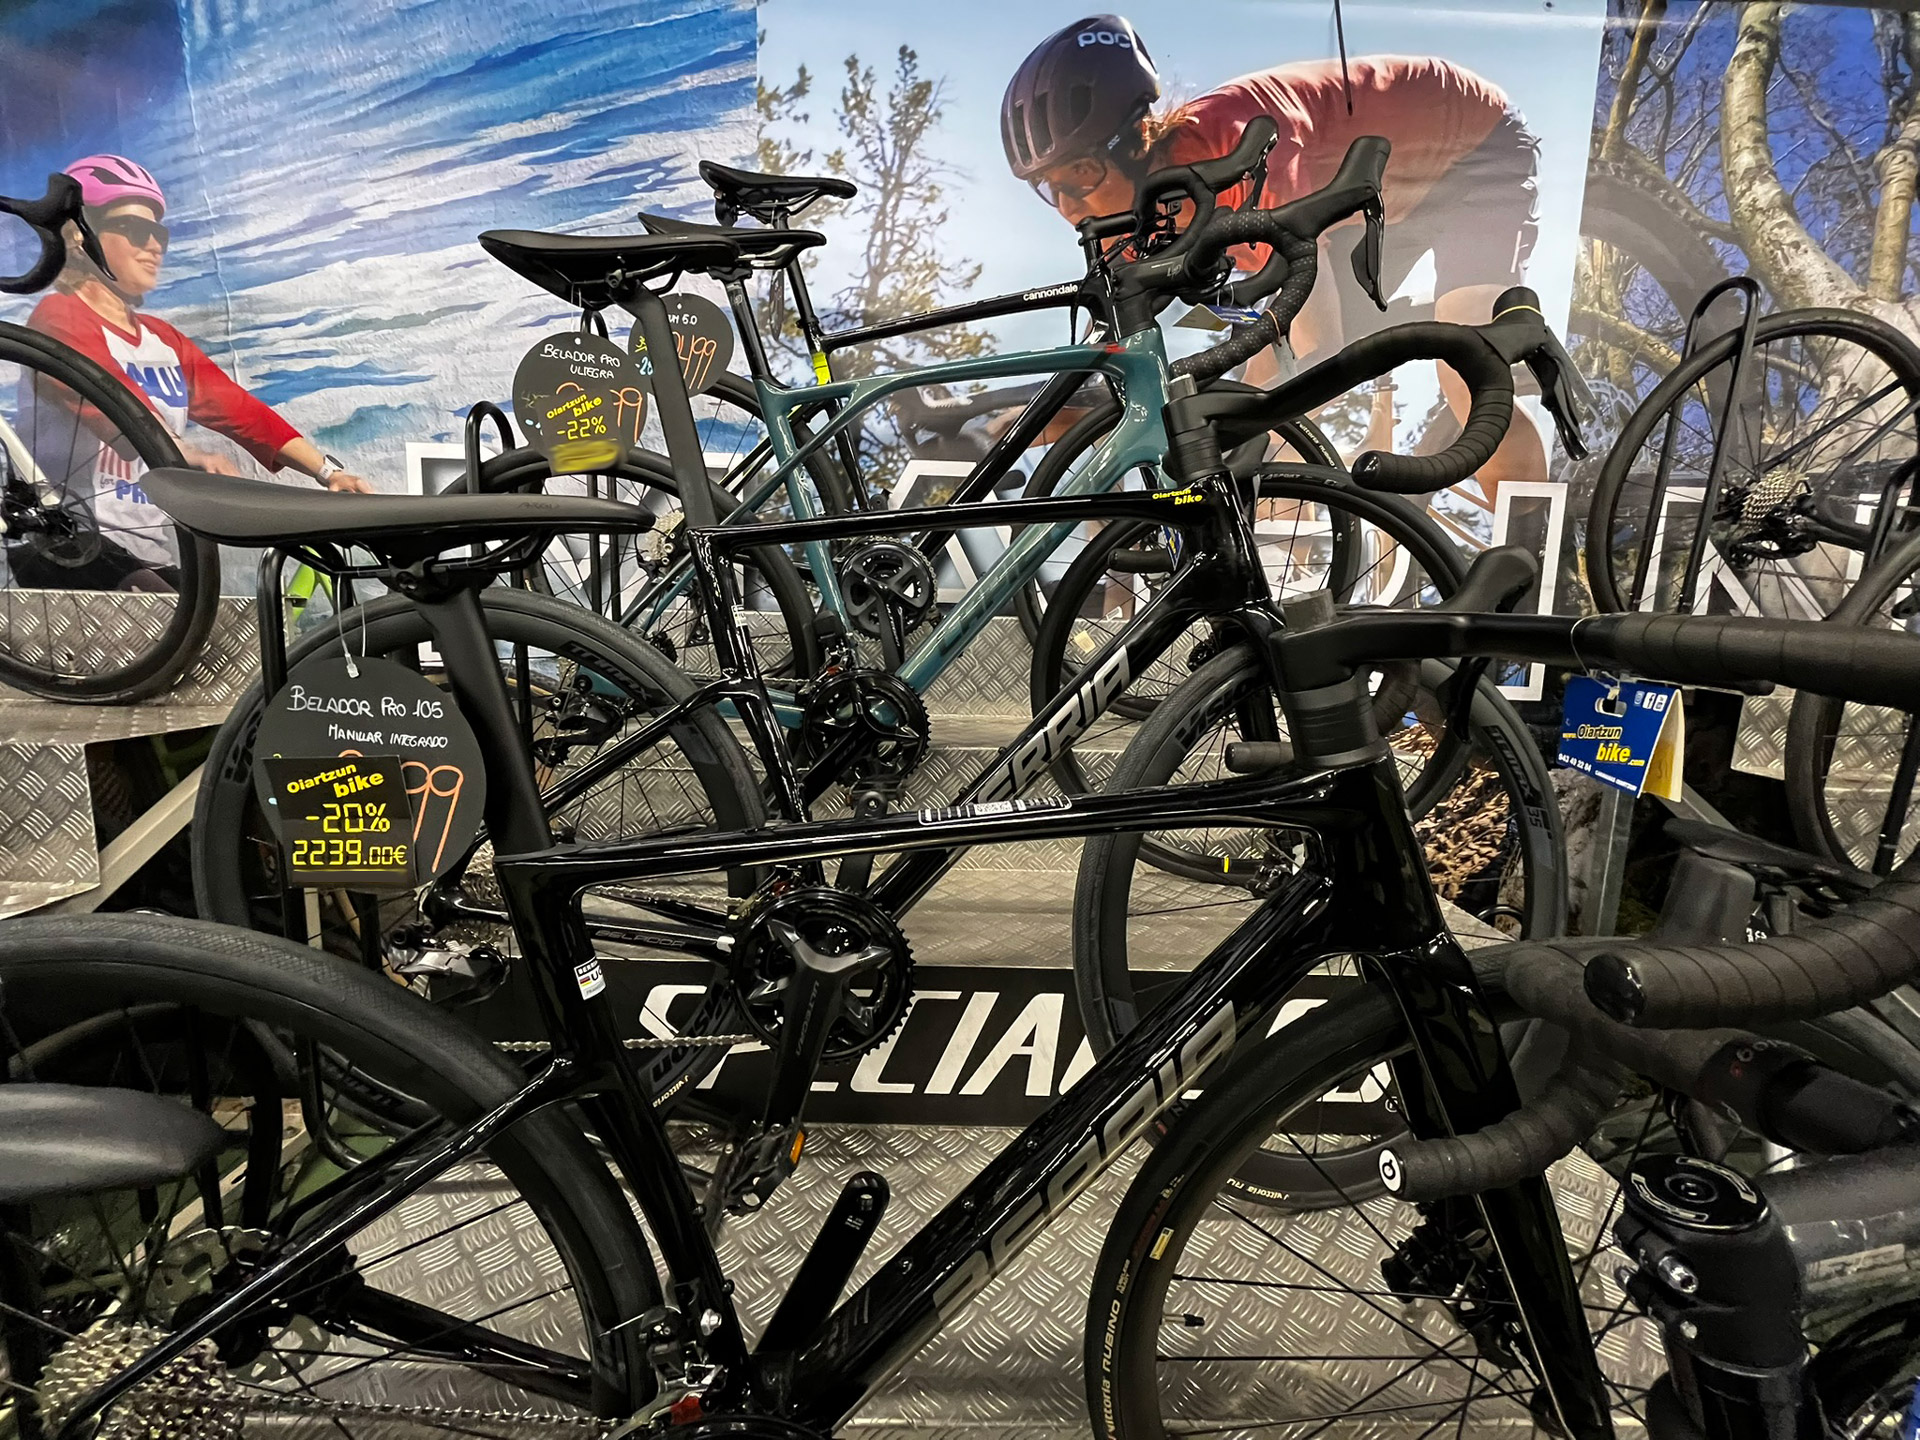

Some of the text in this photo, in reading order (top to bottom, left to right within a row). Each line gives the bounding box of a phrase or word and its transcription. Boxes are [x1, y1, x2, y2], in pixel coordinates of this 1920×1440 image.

[1022, 283, 1079, 302] cannondale
[540, 343, 621, 368] BELADOR PRO
[546, 393, 587, 420] Oiartzun
[573, 397, 603, 418] bike
[557, 416, 607, 440] -22%
[1152, 488, 1192, 500] Oiartzun
[1174, 493, 1203, 506] bike
[287, 684, 374, 718] BELADOR
[411, 699, 444, 719] 105
[328, 723, 448, 748] MANILLAR INTEGRADO
[978, 644, 1131, 803] ERRIA
[1577, 724, 1623, 740] Oiartzun
[286, 763, 357, 794] Oiartzun
[333, 771, 385, 798] bike
[305, 802, 391, 833] -20%
[292, 839, 408, 866] 2239.00€
[1102, 1300, 1122, 1373] RUBINO
